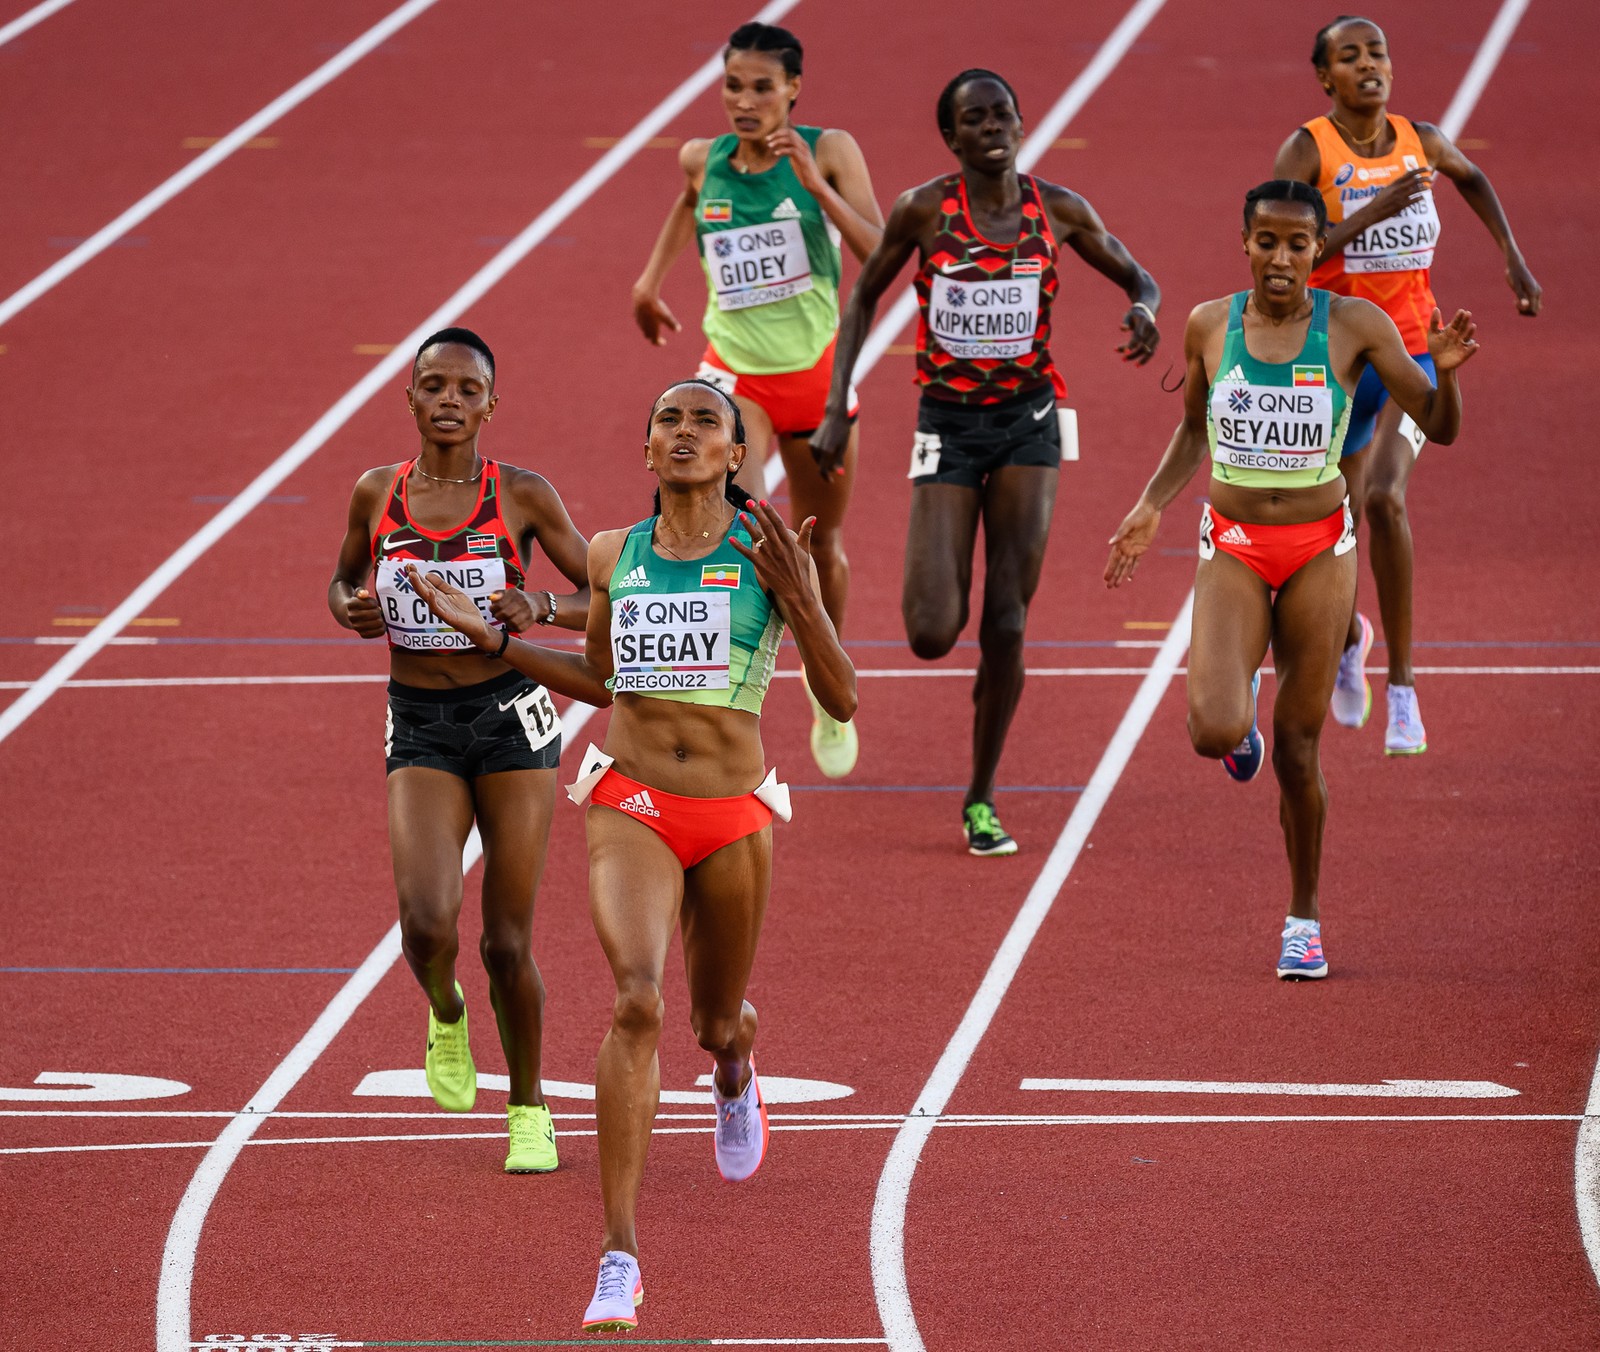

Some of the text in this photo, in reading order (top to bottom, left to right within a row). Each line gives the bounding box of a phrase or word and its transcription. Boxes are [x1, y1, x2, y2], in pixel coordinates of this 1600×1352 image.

[738, 229, 786, 252] QNB
[720, 254, 788, 287] GIDEY
[972, 286, 1023, 307] QNB
[935, 308, 1032, 335] KIPKEMBOI
[945, 343, 1020, 356] OREGON22
[1258, 393, 1314, 414] QNB
[1220, 417, 1323, 447] SEYAUM
[1229, 452, 1309, 469] OREGON22
[618, 577, 651, 589] adidas
[387, 597, 406, 624] B.
[645, 600, 709, 626] QNB
[614, 631, 720, 666] TSEGAY
[615, 673, 707, 690] OREGON22
[526, 694, 554, 738] 15
[619, 801, 661, 818] adidas
